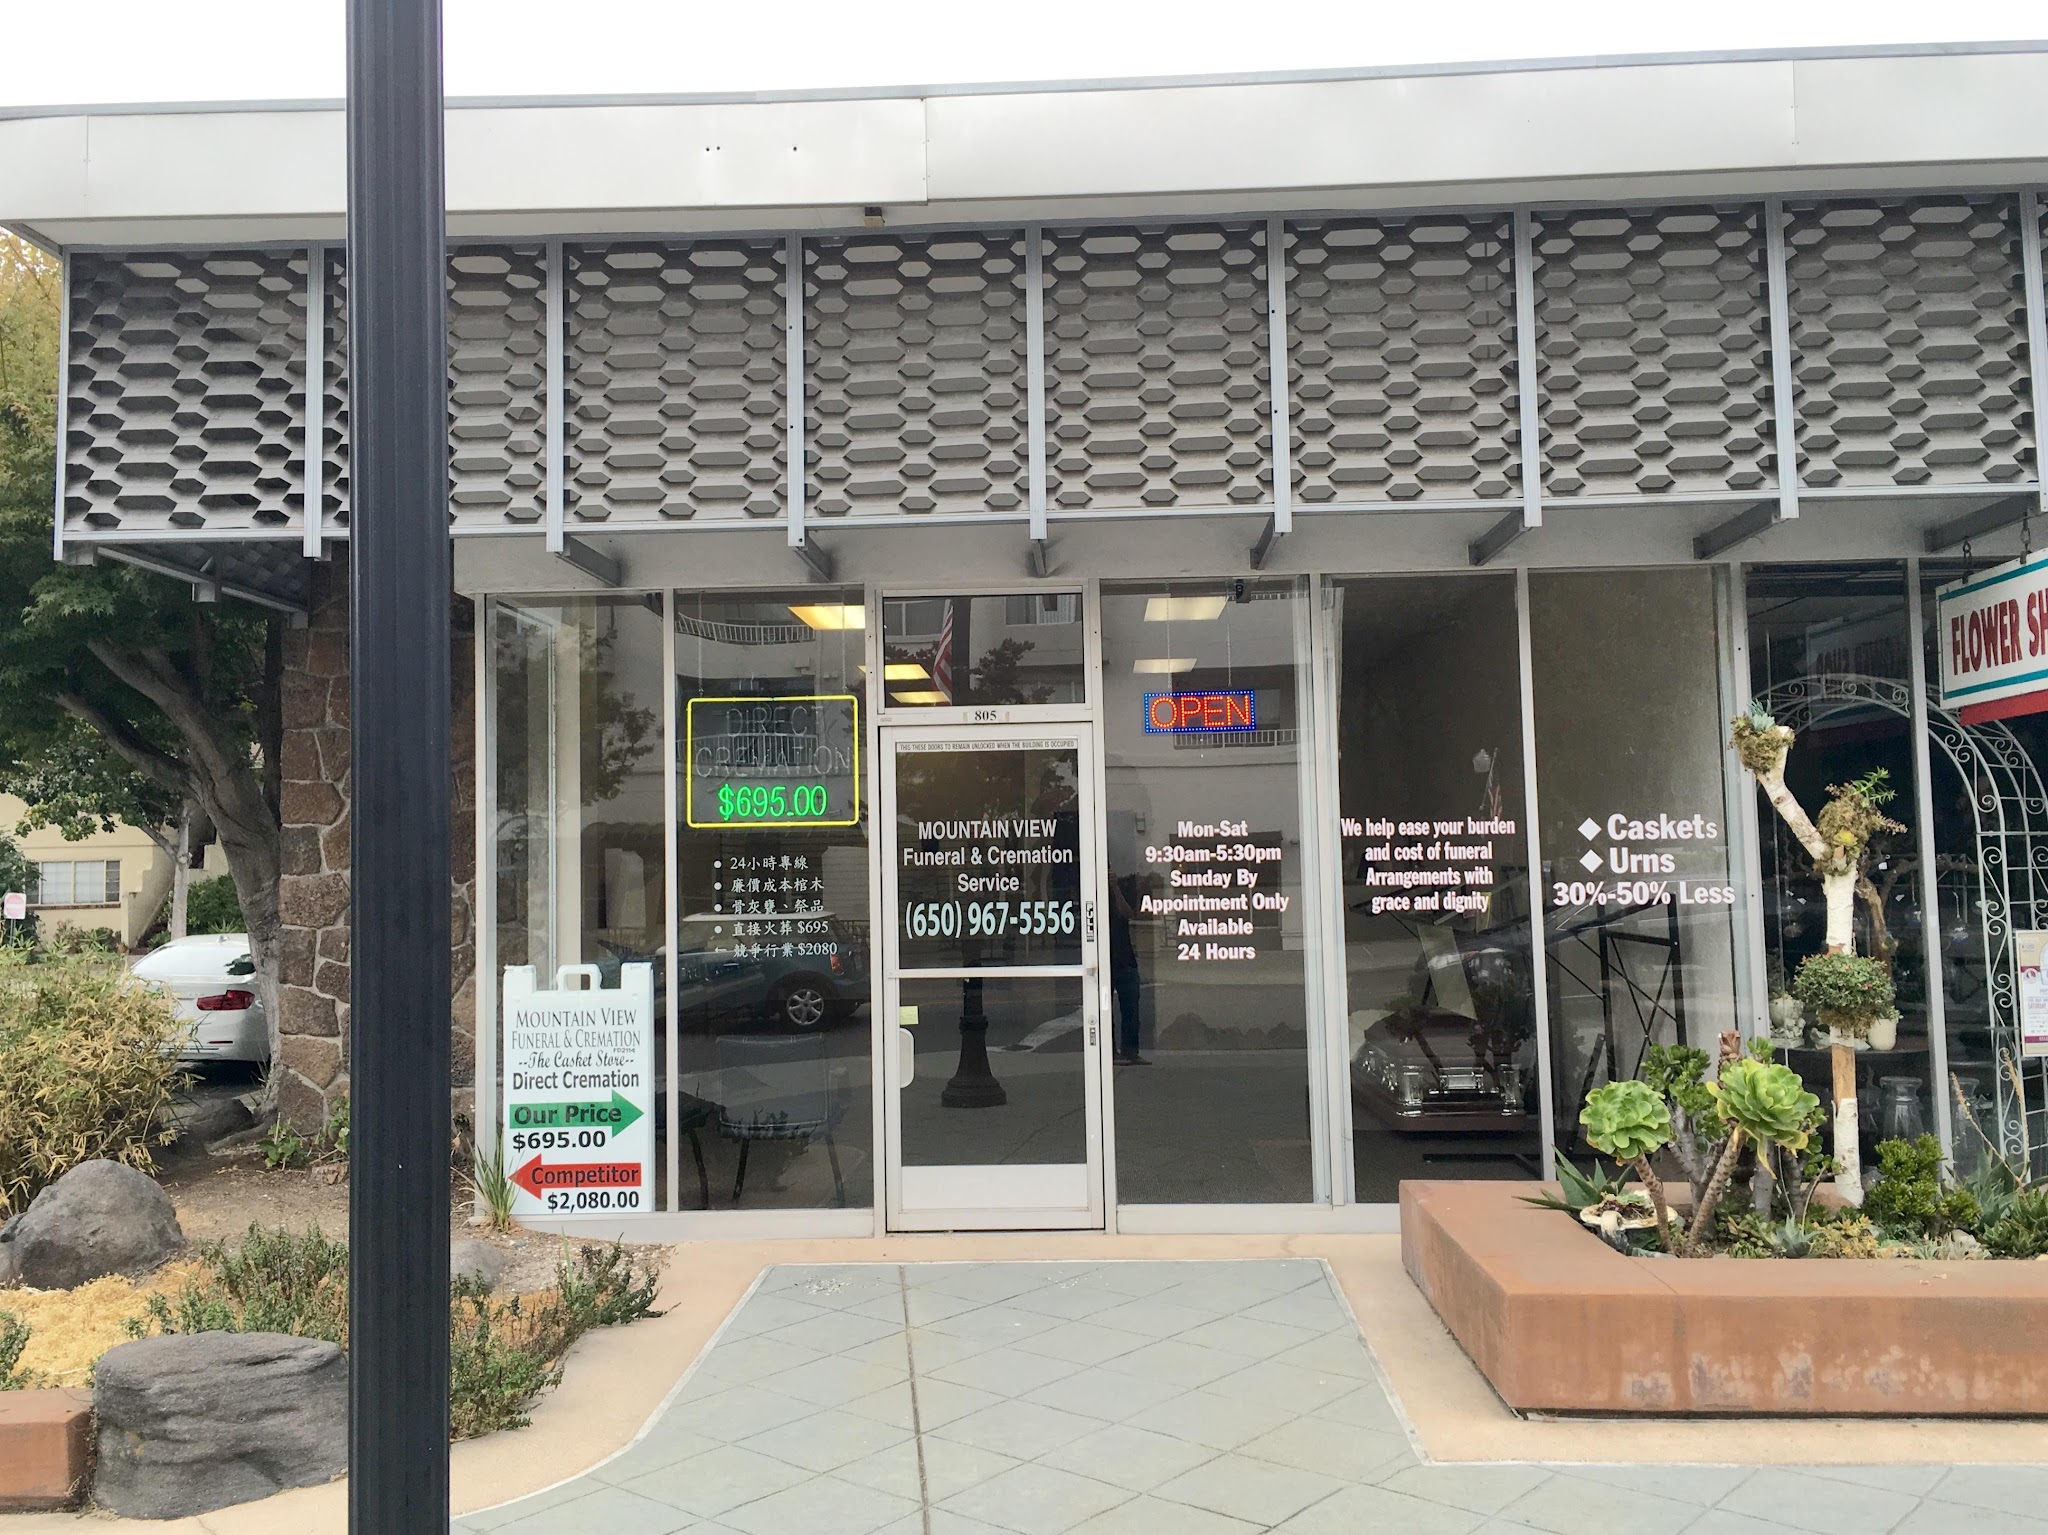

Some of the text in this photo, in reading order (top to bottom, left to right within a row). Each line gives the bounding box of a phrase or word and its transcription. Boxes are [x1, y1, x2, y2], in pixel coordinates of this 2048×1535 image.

[1951, 599, 2022, 676] FLOWER
[2027, 588, 2048, 657] SH
[727, 706, 824, 737] DIRECT
[974, 710, 997, 721] 805
[1151, 695, 1250, 727] OPEN
[696, 745, 850, 777] CREMATION
[718, 784, 827, 820] $695.00
[918, 819, 1057, 840] MOUNTAIN VIEW
[1177, 820, 1248, 838] Mon-Sat
[1341, 816, 1515, 839] We help ease your burden
[1607, 813, 1717, 840] Caskets
[903, 845, 1073, 866] Funeral & Cremation
[1145, 844, 1281, 864] 9:30am-5:30pm
[1365, 841, 1493, 861] and cost of funeral
[1609, 847, 1676, 874] Urns
[730, 855, 809, 870] 24小時專線
[731, 877, 825, 893] 廉價成本棺木
[957, 873, 1019, 891] Service
[1170, 868, 1258, 888] Sunday By
[1365, 866, 1493, 889] Arrangements with
[1140, 892, 1289, 915] Appointment Only
[1371, 891, 1489, 914] grace and dignity
[1552, 881, 1736, 905] 30%-50% Less
[732, 920, 829, 936] 直接火葬 $695
[905, 901, 1075, 939] (650) 967-5556
[1177, 918, 1254, 936] Available
[797, 942, 837, 956] $2080
[1177, 943, 1256, 960] 24 Hours
[563, 1029, 572, 1048] &
[554, 1051, 592, 1068] Casket
[513, 1069, 639, 1089] Direct Cremation
[514, 1104, 621, 1124] Our Price
[512, 1131, 606, 1152] $695.00
[531, 1166, 639, 1187] Competitor
[548, 1191, 639, 1213] $2,080.00
